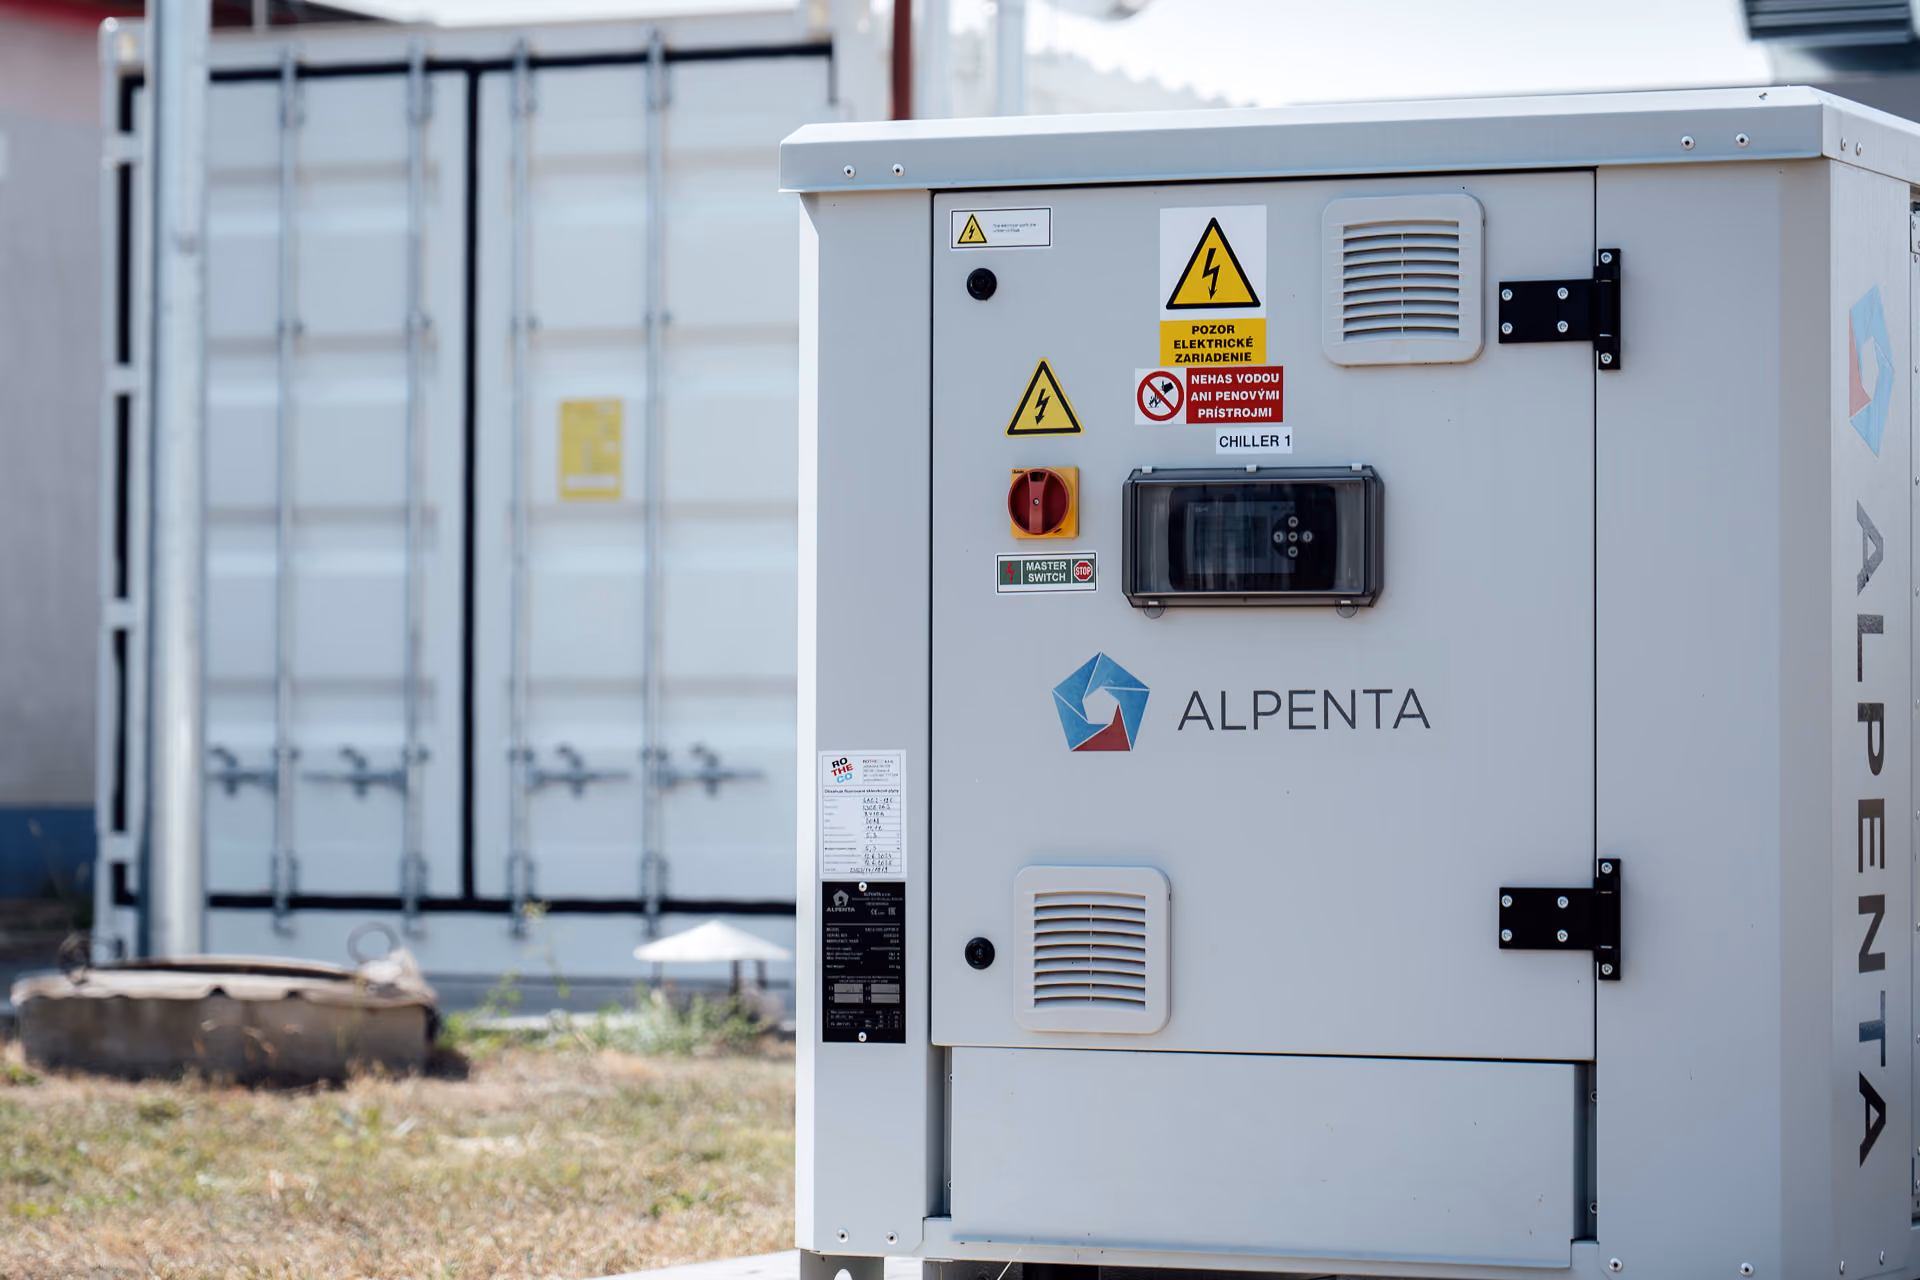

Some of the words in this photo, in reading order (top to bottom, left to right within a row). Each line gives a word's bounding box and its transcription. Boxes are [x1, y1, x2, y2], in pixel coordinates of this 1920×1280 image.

[1191, 324, 1235, 335] POZOR
[1173, 335, 1254, 349] ELEKTRICKÉ
[1174, 352, 1252, 364] ZARIADENIE
[1191, 373, 1233, 385] NEHAS
[1236, 373, 1280, 384] VODOU
[1190, 391, 1212, 402] ANI
[1215, 388, 1280, 401] PENOVÝMI
[1197, 406, 1273, 419] PRÍSTROJMI
[1219, 434, 1280, 448] CHILLER
[1284, 434, 1291, 447] 1
[1026, 561, 1067, 572] MASTER
[1075, 566, 1092, 576] STOP
[1028, 572, 1066, 583] SWITCH
[1177, 687, 1431, 731] ALPENTA
[831, 757, 848, 768] RO
[830, 763, 854, 777] THE
[836, 772, 853, 784] CO
[1856, 499, 1886, 1169] ALPENTA
